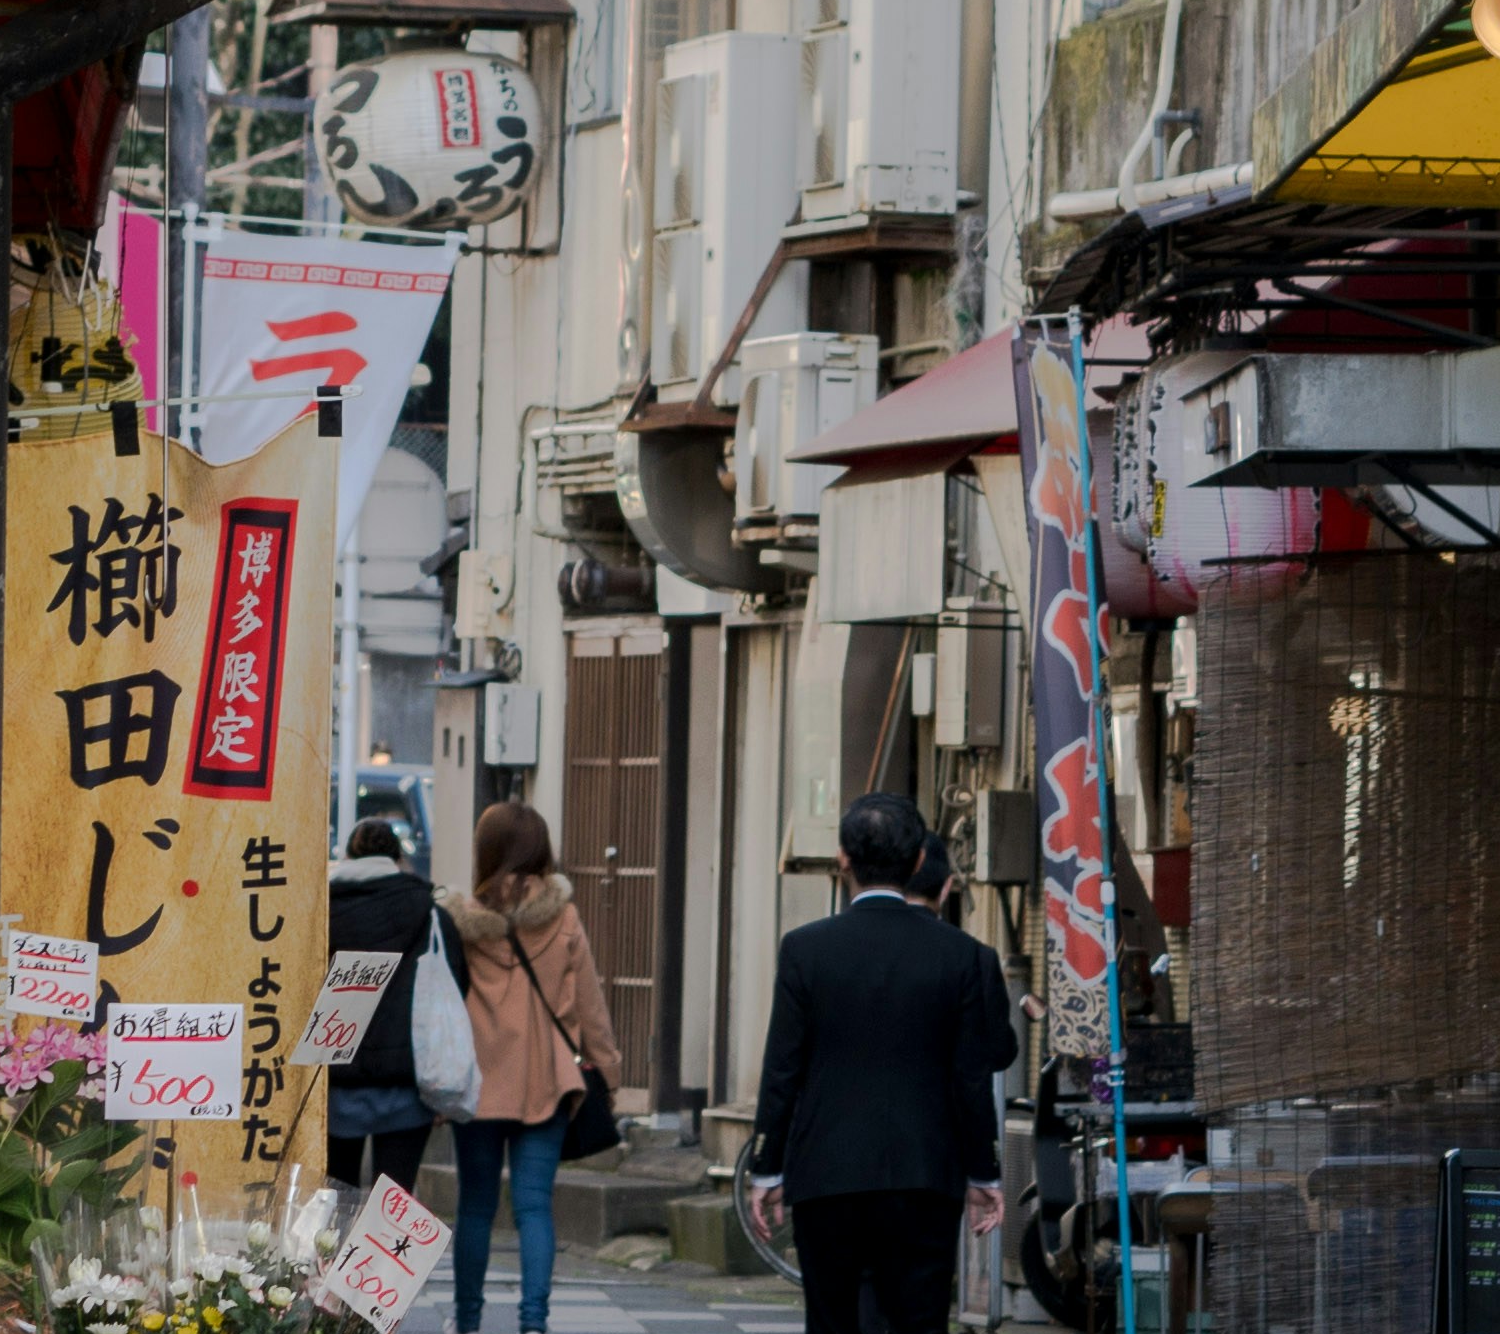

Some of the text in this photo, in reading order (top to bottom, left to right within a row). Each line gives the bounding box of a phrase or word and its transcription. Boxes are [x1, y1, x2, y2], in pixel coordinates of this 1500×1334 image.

[206, 531, 274, 765] 博多限定
[110, 1058, 216, 1106] ¥500
